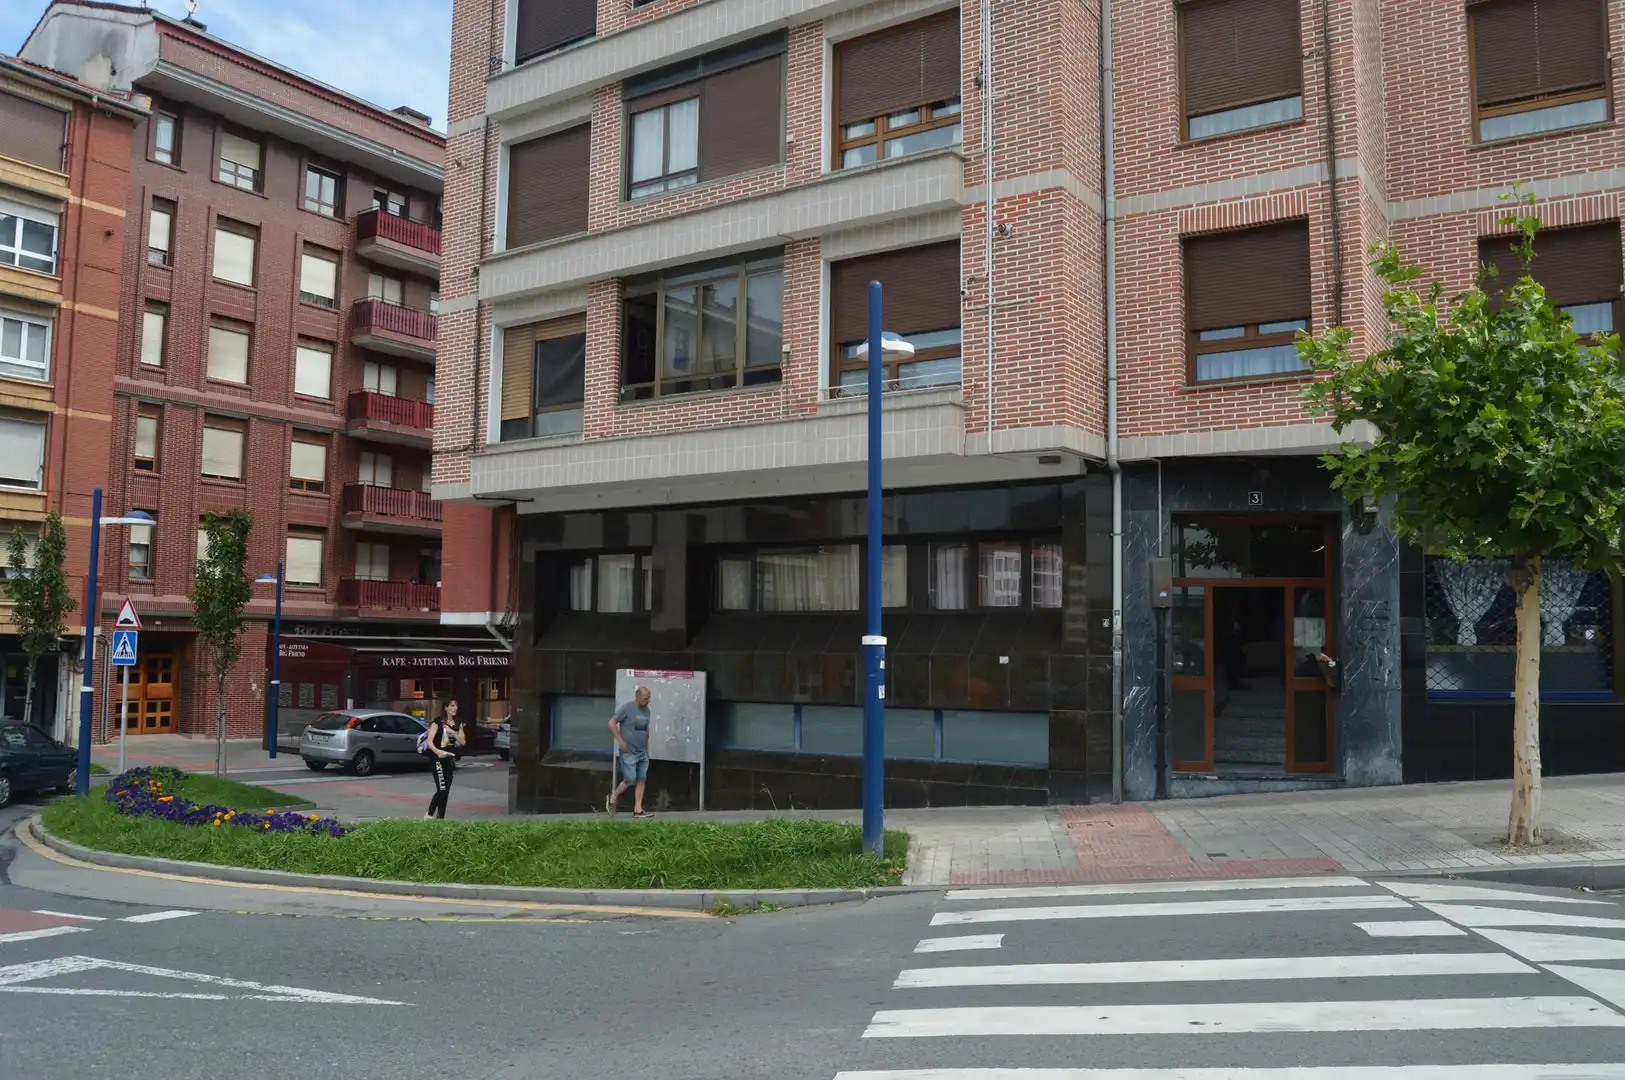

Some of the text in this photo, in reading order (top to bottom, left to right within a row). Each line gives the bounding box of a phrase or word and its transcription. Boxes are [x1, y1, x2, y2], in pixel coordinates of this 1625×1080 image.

[1252, 494, 1260, 504] 3
[382, 657, 406, 666] KAFE
[412, 657, 455, 666] JATETXEA
[458, 655, 475, 666] BIG
[477, 655, 509, 666] FRIEND
